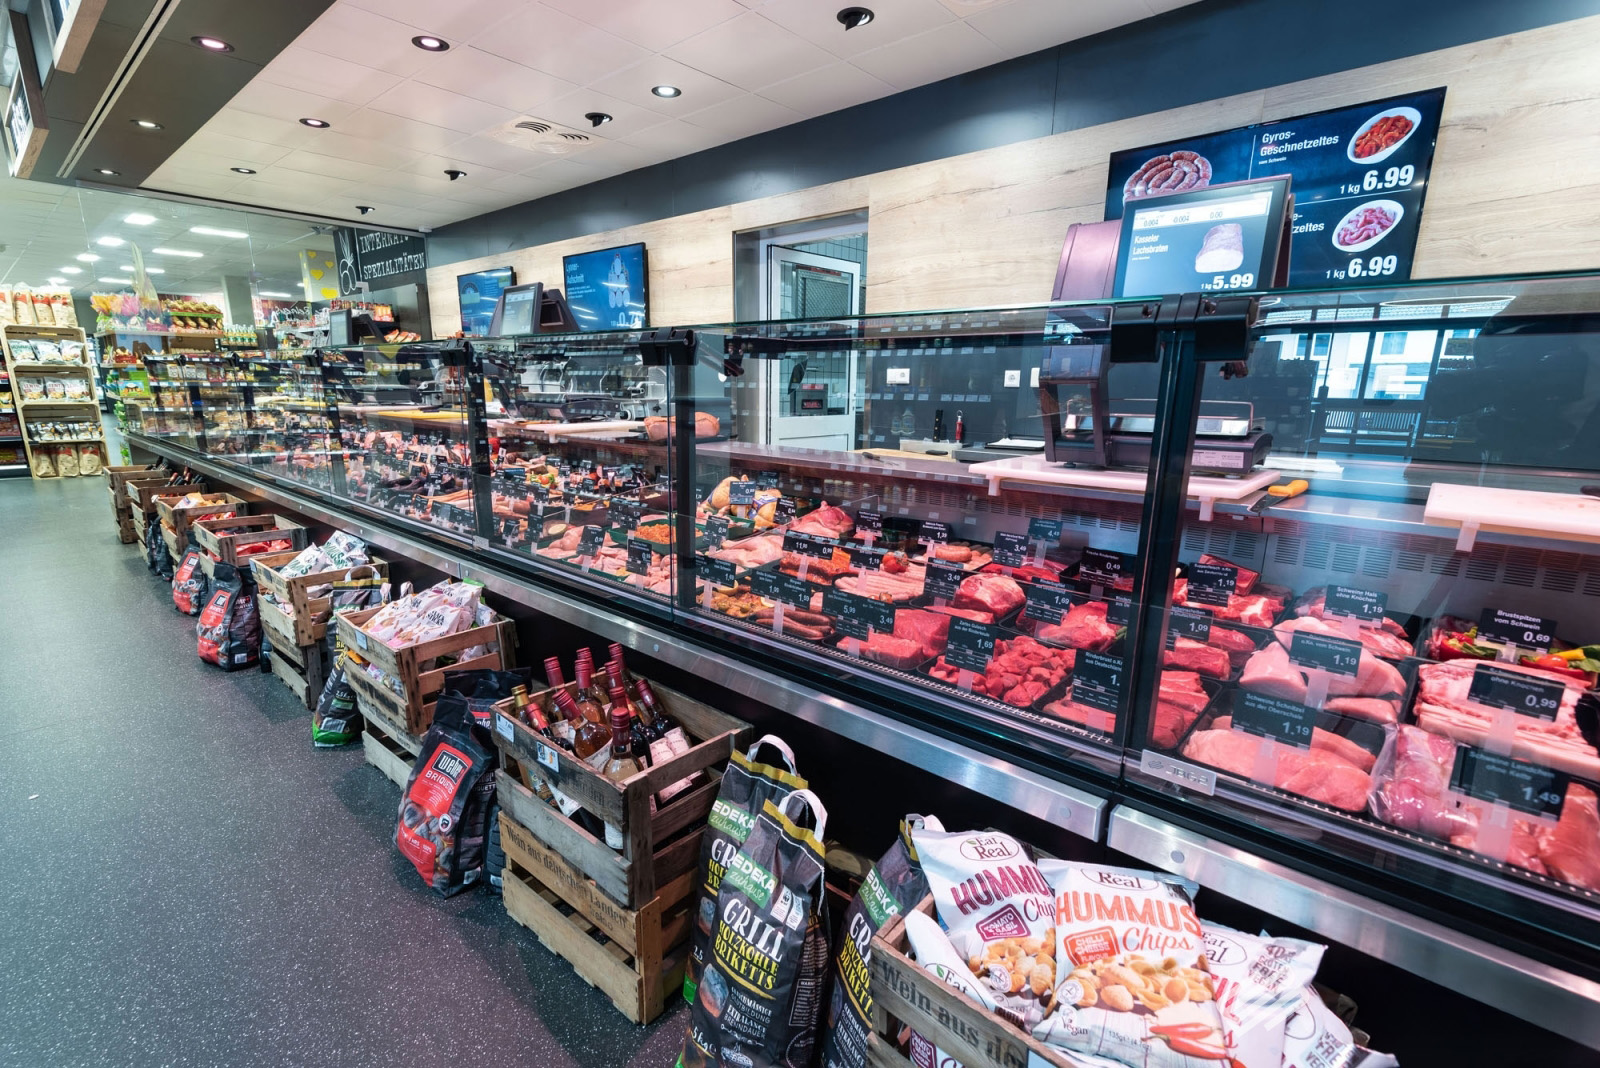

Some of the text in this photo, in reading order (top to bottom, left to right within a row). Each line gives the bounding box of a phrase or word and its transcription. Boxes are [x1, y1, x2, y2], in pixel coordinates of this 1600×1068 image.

[1260, 136, 1339, 157] Geschnetzeltes
[1262, 131, 1295, 146] Gyros-
[1340, 164, 1414, 194] 1 kg 6.99
[360, 232, 408, 254] INTERNA
[1134, 234, 1160, 245] Kasseler
[1132, 244, 1169, 256] Lachsbraten
[363, 252, 425, 280] SPEZIALITÄTEN
[1326, 255, 1397, 280] 1 kg 6.99
[1212, 273, 1254, 290] 5.99
[1218, 578, 1235, 587] 1.19
[1337, 586, 1364, 596] Schweine
[1351, 594, 1377, 603] Knochen
[1362, 604, 1383, 614] 1.19
[1497, 610, 1541, 624] Brustspitzen
[1189, 622, 1209, 633] 1.09
[1494, 617, 1541, 631] vom Schwein
[977, 639, 993, 649] 1.69
[1523, 631, 1551, 643] 0.69
[1333, 654, 1357, 666] 1.19
[1110, 674, 1120, 687] 1.
[1490, 676, 1509, 686] ohne
[1246, 693, 1275, 707] Schweine
[1525, 694, 1557, 710] 0.99
[1282, 721, 1310, 737] 1.19
[438, 755, 463, 779] weber
[1522, 786, 1561, 805] 1.49
[712, 801, 756, 830] EDEKA
[710, 815, 747, 840] zuhause
[506, 825, 526, 851] Wein
[527, 846, 542, 865] aus
[973, 842, 1012, 860] Real
[976, 836, 999, 847] Eat
[731, 854, 776, 894] EDEKA
[1098, 871, 1141, 891] Real
[730, 870, 766, 903] zuhause
[865, 869, 899, 915] EDEKA
[950, 865, 1051, 916] HUMMU
[1023, 897, 1056, 922] Chip
[1056, 891, 1202, 938] HUMMUS
[723, 898, 784, 963] GRILL
[985, 912, 1015, 931] TOMATO
[996, 922, 1018, 934] BASIL
[719, 919, 780, 978] HOLZKOHLE
[1075, 943, 1110, 955] CHEESE
[1076, 934, 1105, 947] CHILLI
[1122, 927, 1195, 957] Chips
[715, 934, 777, 991] BRIKETTS
[845, 931, 871, 988] HOLZKO
[1081, 954, 1109, 964] FLAVOUR
[1206, 947, 1227, 964] al
[840, 947, 873, 1018] BRIKETT
[880, 960, 980, 1046] Wein aus
[723, 1014, 766, 1042] BRENNDAUER
[727, 1003, 767, 1036] EXTRALANGE
[1062, 1015, 1088, 1036] Vegan
